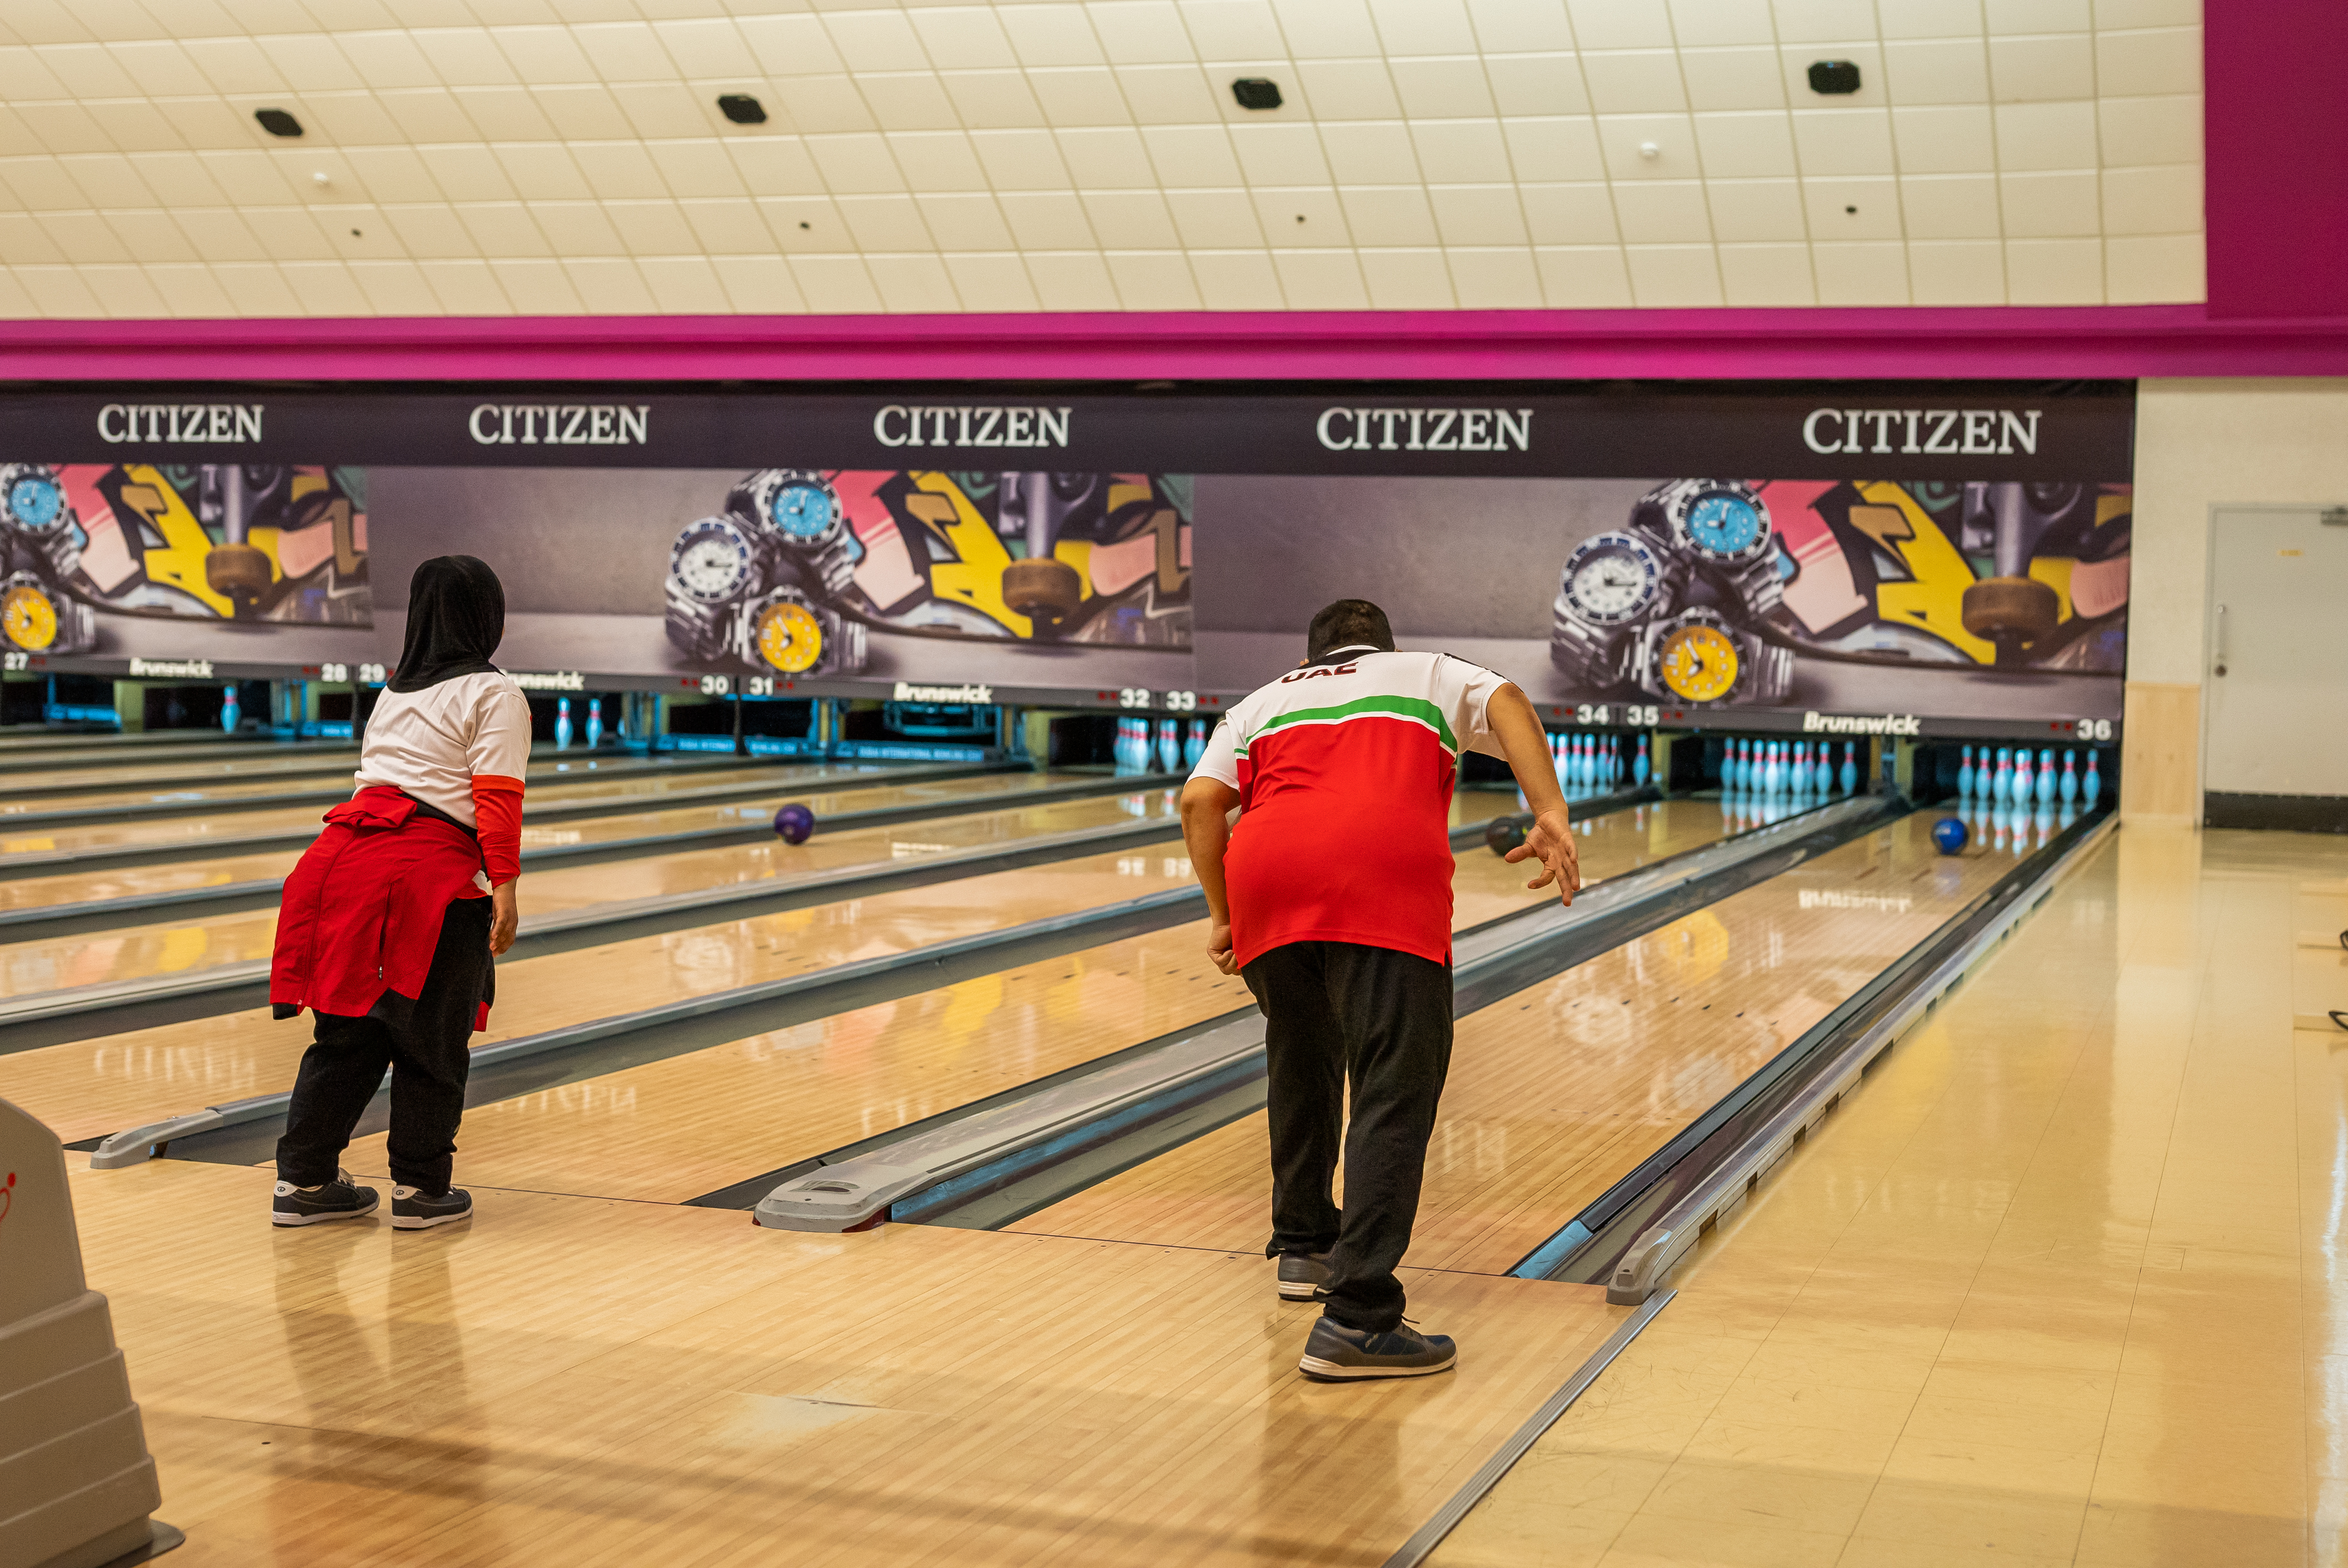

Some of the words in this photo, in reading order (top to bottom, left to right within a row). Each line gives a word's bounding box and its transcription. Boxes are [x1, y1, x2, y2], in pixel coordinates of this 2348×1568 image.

[97, 405, 264, 442] CITIZEN
[468, 405, 650, 445] CITIZEN
[873, 406, 1072, 447] CITIZEN
[1316, 408, 1533, 451] CITIZEN
[1803, 409, 2042, 454] CITIZEN
[4, 652, 28, 670] 27
[322, 663, 347, 682] 28
[359, 663, 385, 682] 29
[1281, 662, 1358, 683] UAE
[701, 675, 729, 695] 30
[750, 676, 773, 696] 31
[894, 682, 992, 704] Brunswick
[1120, 688, 1150, 708] 32
[1166, 690, 1196, 711] 33
[1577, 704, 1609, 725] 34
[1627, 705, 1659, 726] 35
[1803, 710, 1920, 736] Brunswick
[2077, 719, 2112, 740] 36
